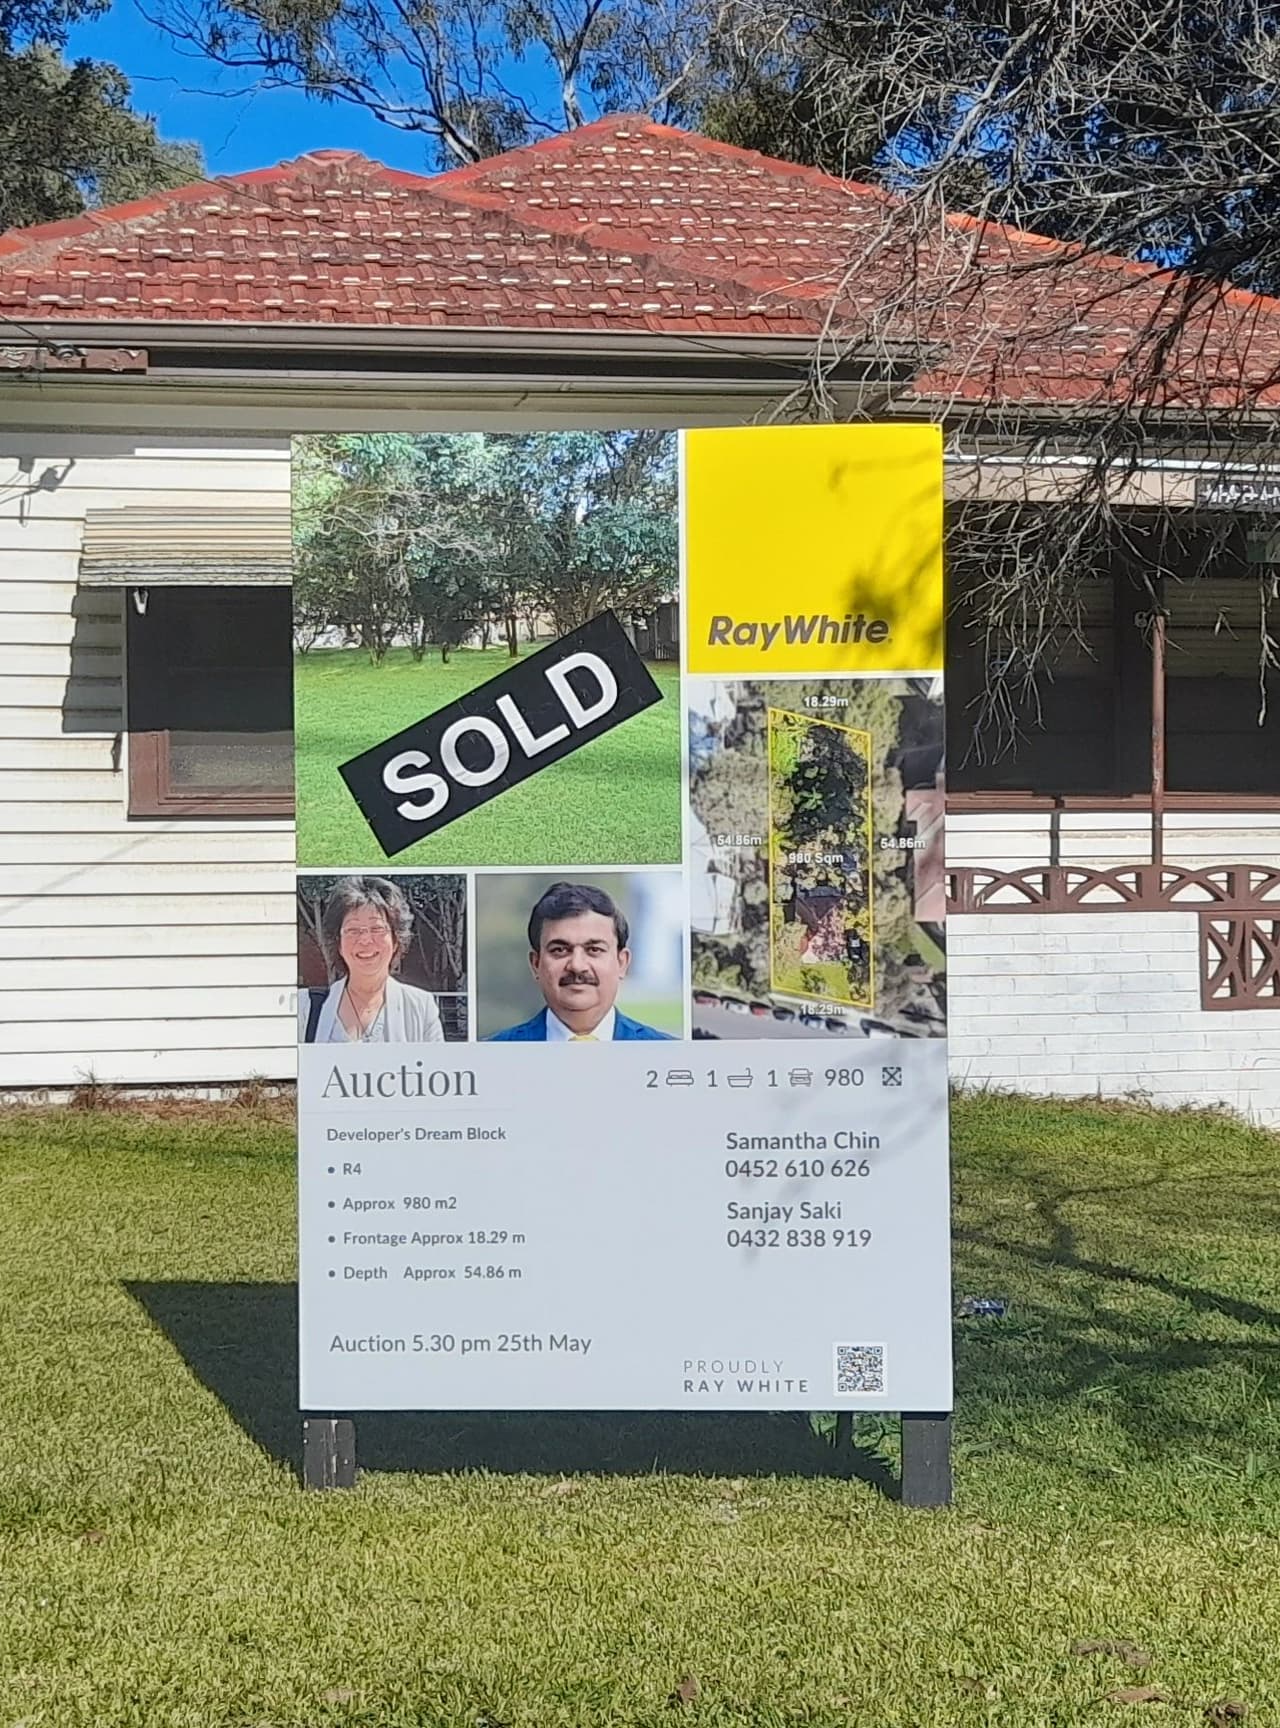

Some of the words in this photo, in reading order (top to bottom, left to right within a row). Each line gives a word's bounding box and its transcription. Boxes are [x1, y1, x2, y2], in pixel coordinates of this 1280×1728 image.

[804, 696, 849, 708] 18.29m
[384, 652, 618, 821] SOLD
[880, 838, 926, 849] 54.86m
[788, 853, 811, 864] 980
[815, 853, 844, 866] Sqm
[322, 1061, 478, 1097] Auction
[647, 1070, 658, 1088] 2
[707, 1070, 718, 1087] 1
[768, 1070, 778, 1087] 1
[825, 1069, 864, 1086] 980
[327, 1128, 410, 1143] Developer's
[415, 1128, 462, 1140] Dream
[467, 1127, 506, 1140] Block
[727, 1132, 826, 1149] Samantha
[834, 1132, 879, 1149] Chin
[343, 1163, 361, 1175] R4
[726, 1160, 778, 1177] 0452
[785, 1160, 824, 1177] 610
[831, 1160, 870, 1177] 626
[343, 1198, 395, 1212] Approx
[403, 1197, 431, 1209] 980
[435, 1197, 456, 1209] m2
[728, 1202, 793, 1223] Sanjay
[800, 1201, 841, 1219] Saki
[344, 1232, 407, 1247] Frontage
[411, 1232, 463, 1246] Approx
[469, 1231, 507, 1244] 18.29
[513, 1234, 525, 1243] m
[727, 1230, 779, 1247] 0432
[787, 1230, 825, 1247] 838
[833, 1229, 871, 1247] 919
[344, 1266, 387, 1281] Depth
[404, 1266, 455, 1281] Approx
[465, 1266, 504, 1278] 54.86
[509, 1269, 521, 1278] m
[330, 1335, 405, 1352] Auction
[413, 1335, 455, 1352] 5.30
[462, 1339, 490, 1355] pm
[498, 1334, 542, 1351] 25th
[550, 1334, 591, 1354] May
[684, 1360, 783, 1373] PROUDLY
[684, 1380, 723, 1392] RAY
[737, 1380, 807, 1392] WHITE
